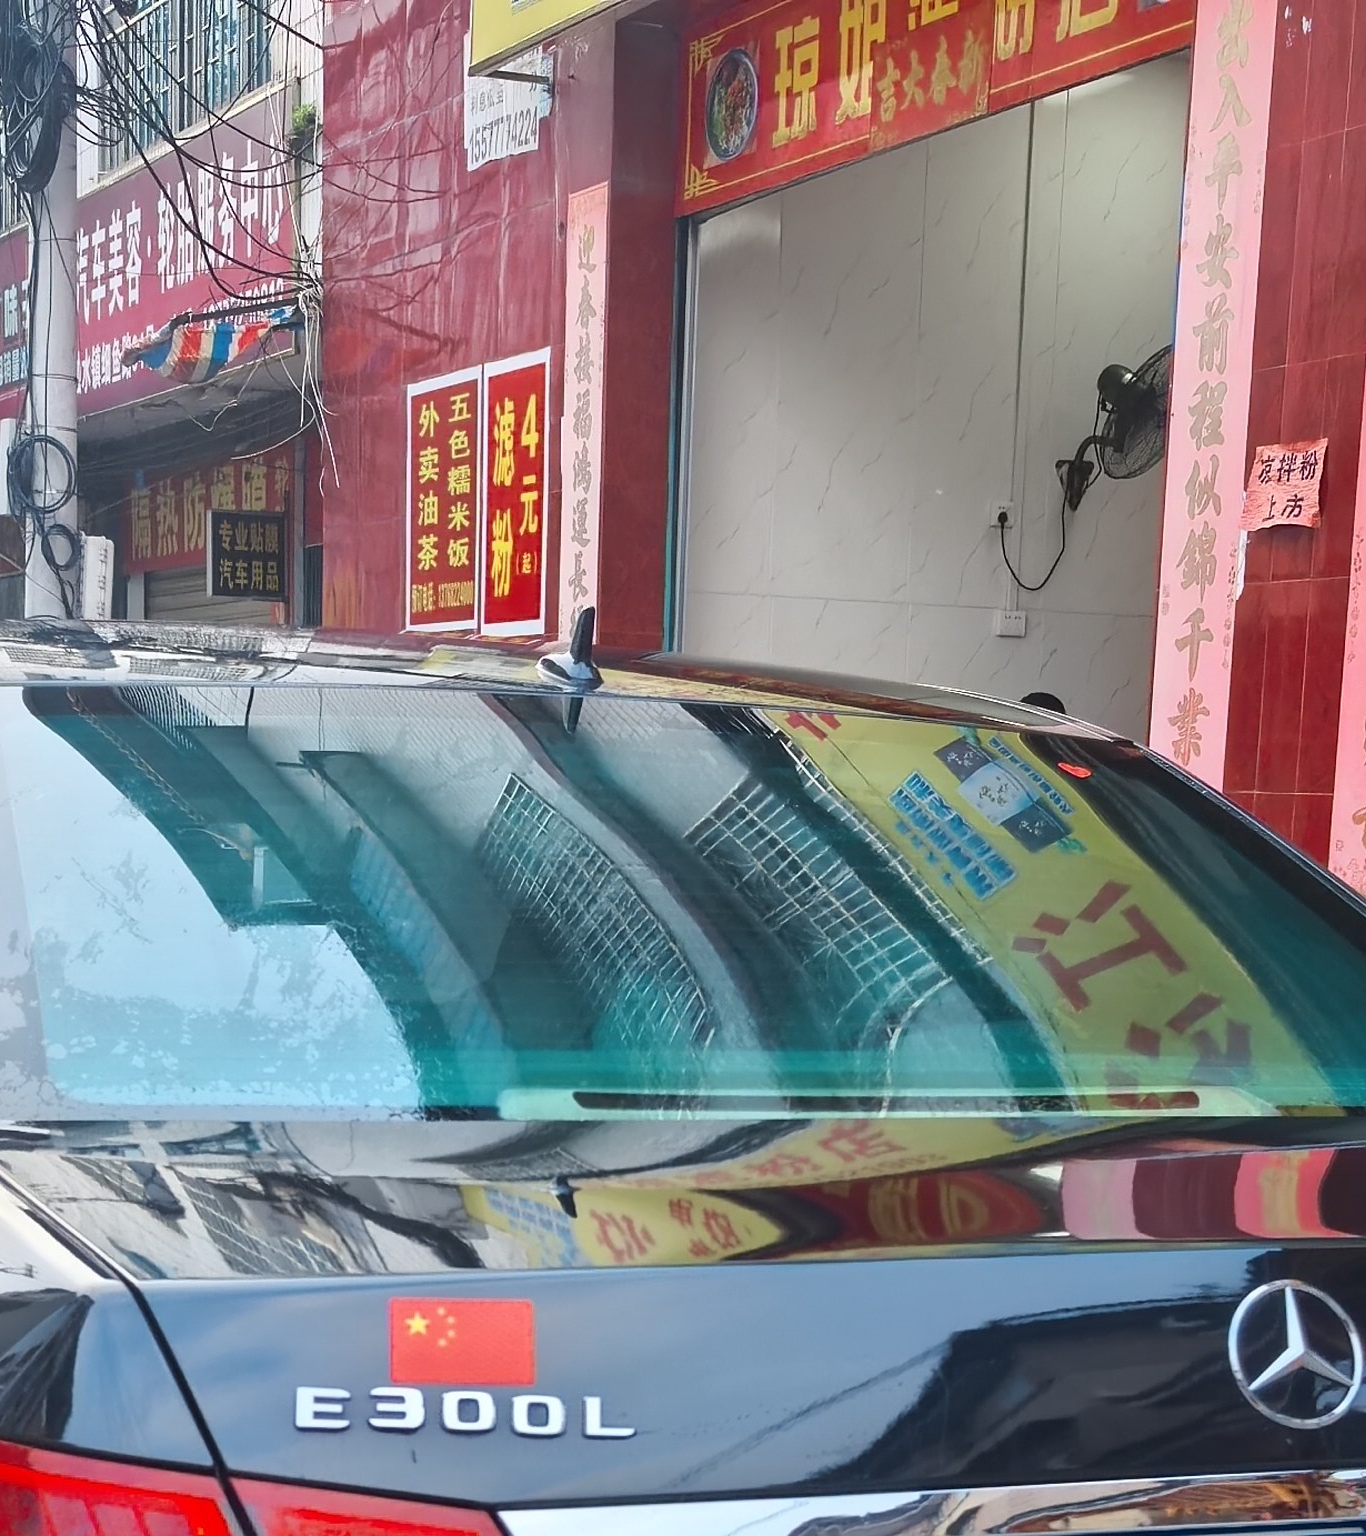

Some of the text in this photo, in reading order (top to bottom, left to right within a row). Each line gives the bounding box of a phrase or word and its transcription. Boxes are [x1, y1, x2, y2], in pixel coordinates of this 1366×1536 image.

[418, 401, 439, 572] 外卖油茶
[447, 392, 471, 568] 五色糯米饭
[491, 397, 515, 598] 滤粉
[1262, 494, 1305, 522] 上市
[219, 520, 279, 554] 专业贴膜
[219, 558, 279, 592] 汽车用品
[294, 1386, 636, 1439] E300L
